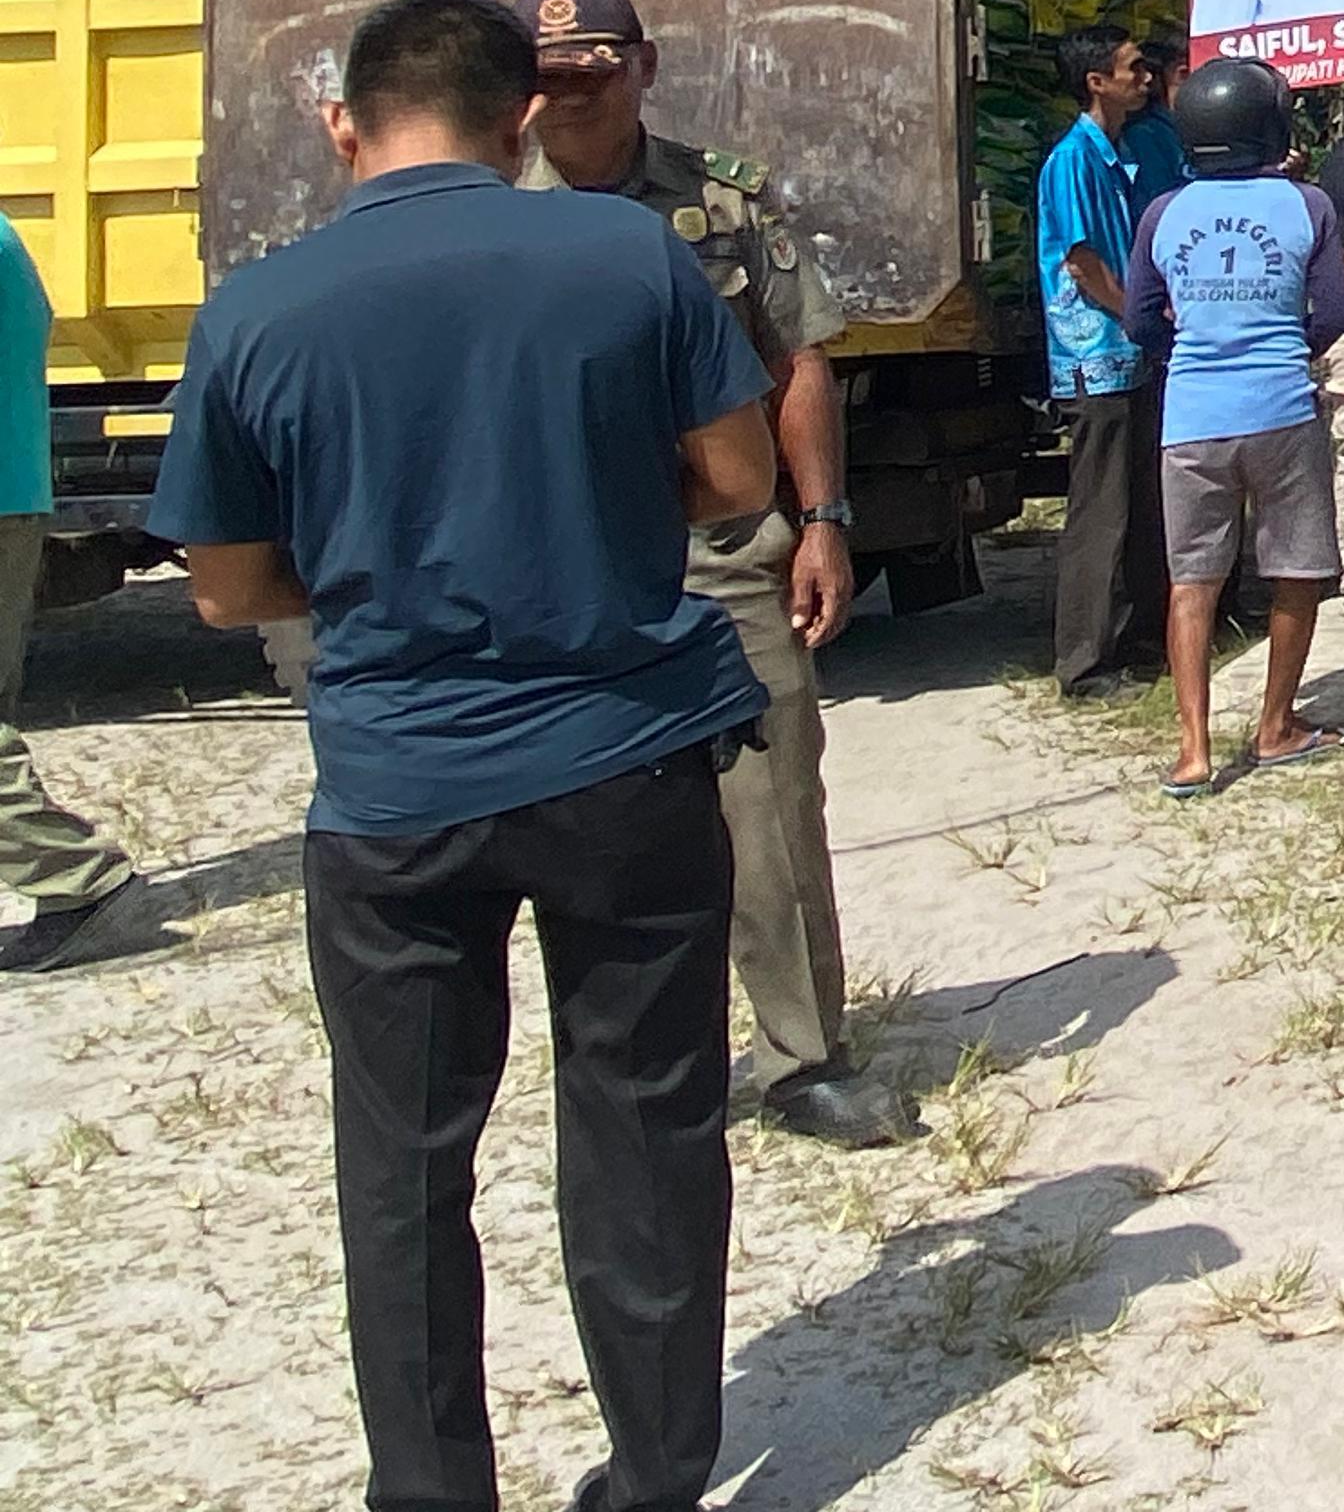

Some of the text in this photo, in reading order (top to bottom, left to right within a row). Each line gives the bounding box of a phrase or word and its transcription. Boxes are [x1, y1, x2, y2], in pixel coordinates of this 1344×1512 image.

[1219, 25, 1326, 59] SAIFUL,
[1173, 217, 1283, 276] SMA NEGERI
[1220, 246, 1236, 274] 1
[1177, 288, 1278, 302] KASONGAN
